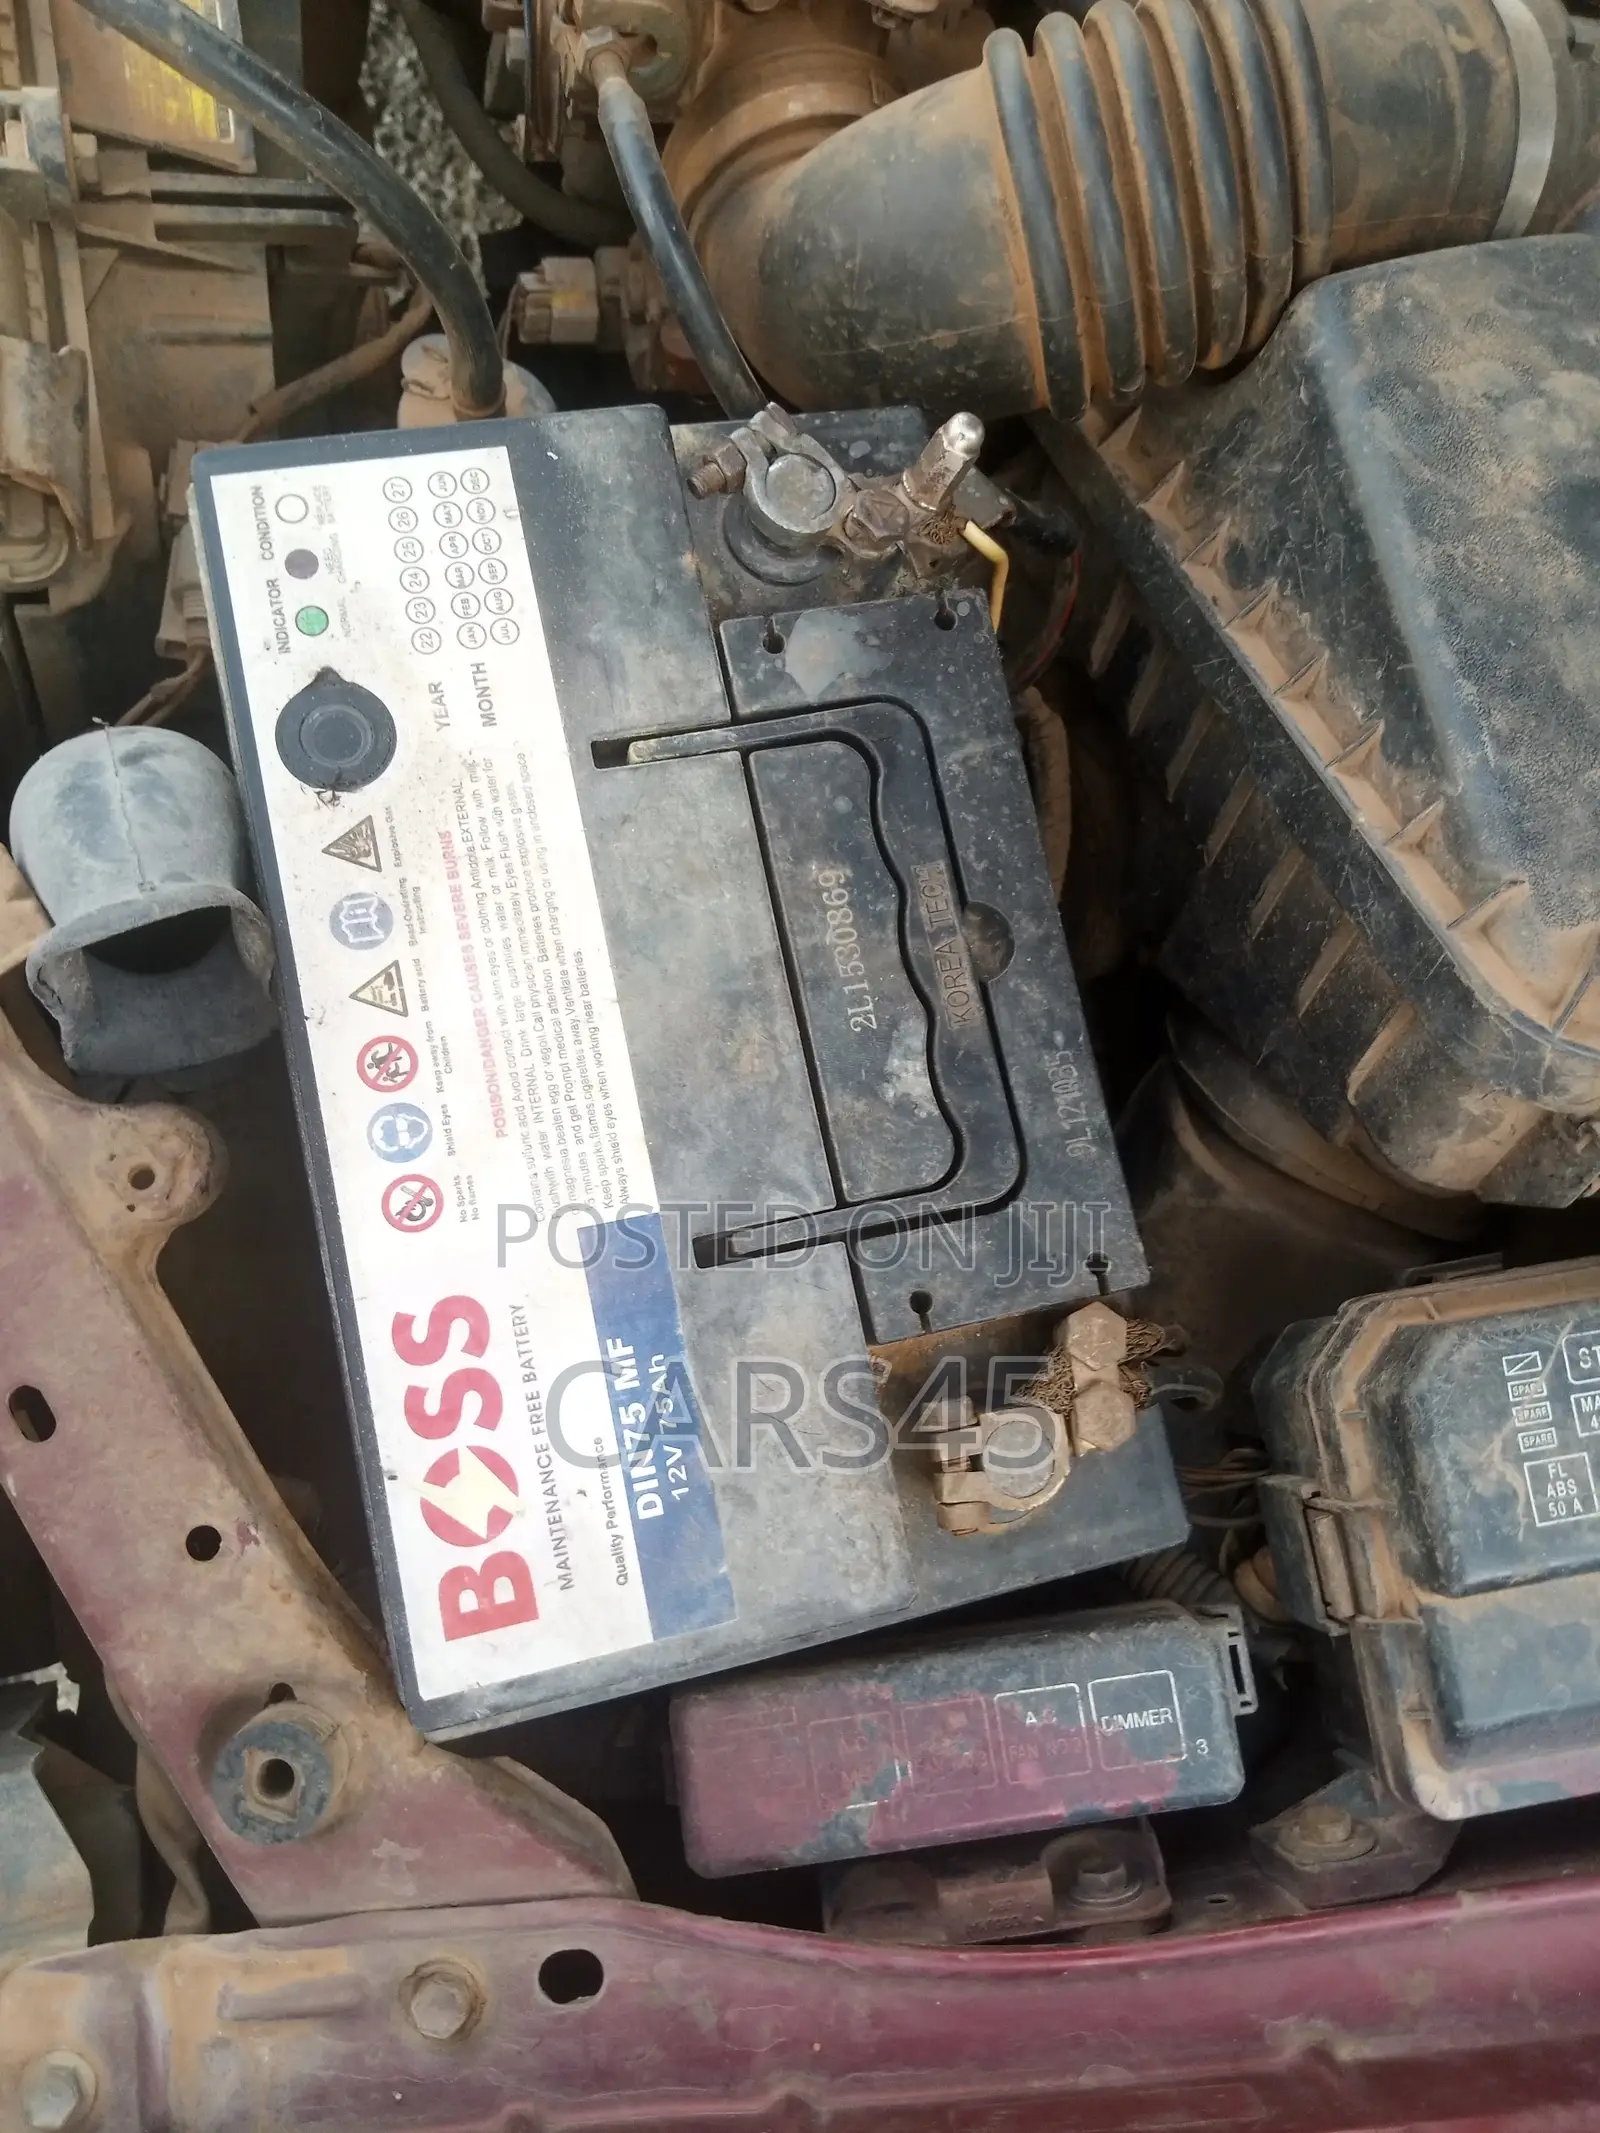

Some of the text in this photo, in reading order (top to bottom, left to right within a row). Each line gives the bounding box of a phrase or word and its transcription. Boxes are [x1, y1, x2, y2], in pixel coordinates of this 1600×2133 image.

[436, 473, 448, 492] JUN
[442, 504, 454, 524] MAY
[447, 534, 460, 554] APR
[469, 470, 510, 640] JUL AUG SEP OCT NOV DEC
[248, 485, 291, 654] INDICATOR CONDITION
[390, 481, 451, 731] YEAR 22 23 24 25 26 27
[459, 597, 471, 616] FEB
[465, 626, 477, 645] JAN
[470, 661, 497, 727] MONTH
[480, 756, 493, 772] for
[515, 751, 533, 783] space
[470, 788, 484, 810] with
[485, 773, 500, 804] water
[474, 815, 492, 851] Follow
[511, 816, 532, 867] explosive
[531, 834, 542, 844] in
[438, 829, 460, 880] BURNS
[489, 883, 501, 895] or
[520, 868, 540, 913] produce
[540, 877, 551, 889] or
[448, 882, 471, 941] SEVERE
[473, 891, 494, 934] clothing
[492, 900, 509, 931] water
[542, 889, 563, 936] charging
[483, 936, 494, 948] or
[529, 915, 548, 963] Batteries
[551, 937, 567, 967] when
[411, 957, 431, 1012] Battery acid
[460, 943, 483, 1004] CAUSES
[933, 939, 973, 1024] KOREA
[510, 993, 528, 1022] large
[540, 967, 559, 1015] attention
[494, 1003, 509, 1026] with
[581, 998, 595, 1024] near
[438, 1034, 454, 1074] Children
[499, 1027, 517, 1069] contact
[515, 1027, 532, 1057] Drink
[549, 1016, 568, 1060] medical
[586, 1025, 606, 1069] working
[423, 1020, 446, 1093] Keep away from
[506, 1070, 523, 1103] Avoid
[544, 1067, 555, 1081] or
[557, 1060, 578, 1102] Prompt
[594, 1070, 610, 1100] when
[547, 1082, 562, 1105] egg
[513, 1104, 528, 1128] acid
[566, 1103, 582, 1122] get
[602, 1101, 618, 1129] eyes
[438, 1102, 456, 1157] Shield Eyes
[535, 1128, 552, 1161] water
[570, 1123, 584, 1145] and
[606, 1131, 622, 1165] shield
[575, 1150, 594, 1195] minutes
[613, 1165, 632, 1205] Always
[451, 1173, 468, 1223] No Sparks
[463, 1173, 480, 1220] No flames
[598, 1177, 616, 1209] Keep
[605, 1333, 665, 1521] DIN75 MF
[646, 1351, 691, 1501] 12V 75Ah
[1522, 1431, 1553, 1448] SPARE
[507, 1301, 575, 1591] MAINTENANCE FREE BATTERY
[385, 1288, 542, 1644] BOSS
[1548, 1463, 1568, 1479] FL
[1547, 1478, 1577, 1498] ABS
[590, 1435, 631, 1587] Quality Performance
[1548, 1497, 1583, 1517] 50 A
[1100, 1707, 1173, 1732] DIMMER
[1195, 1738, 1209, 1756] 3
